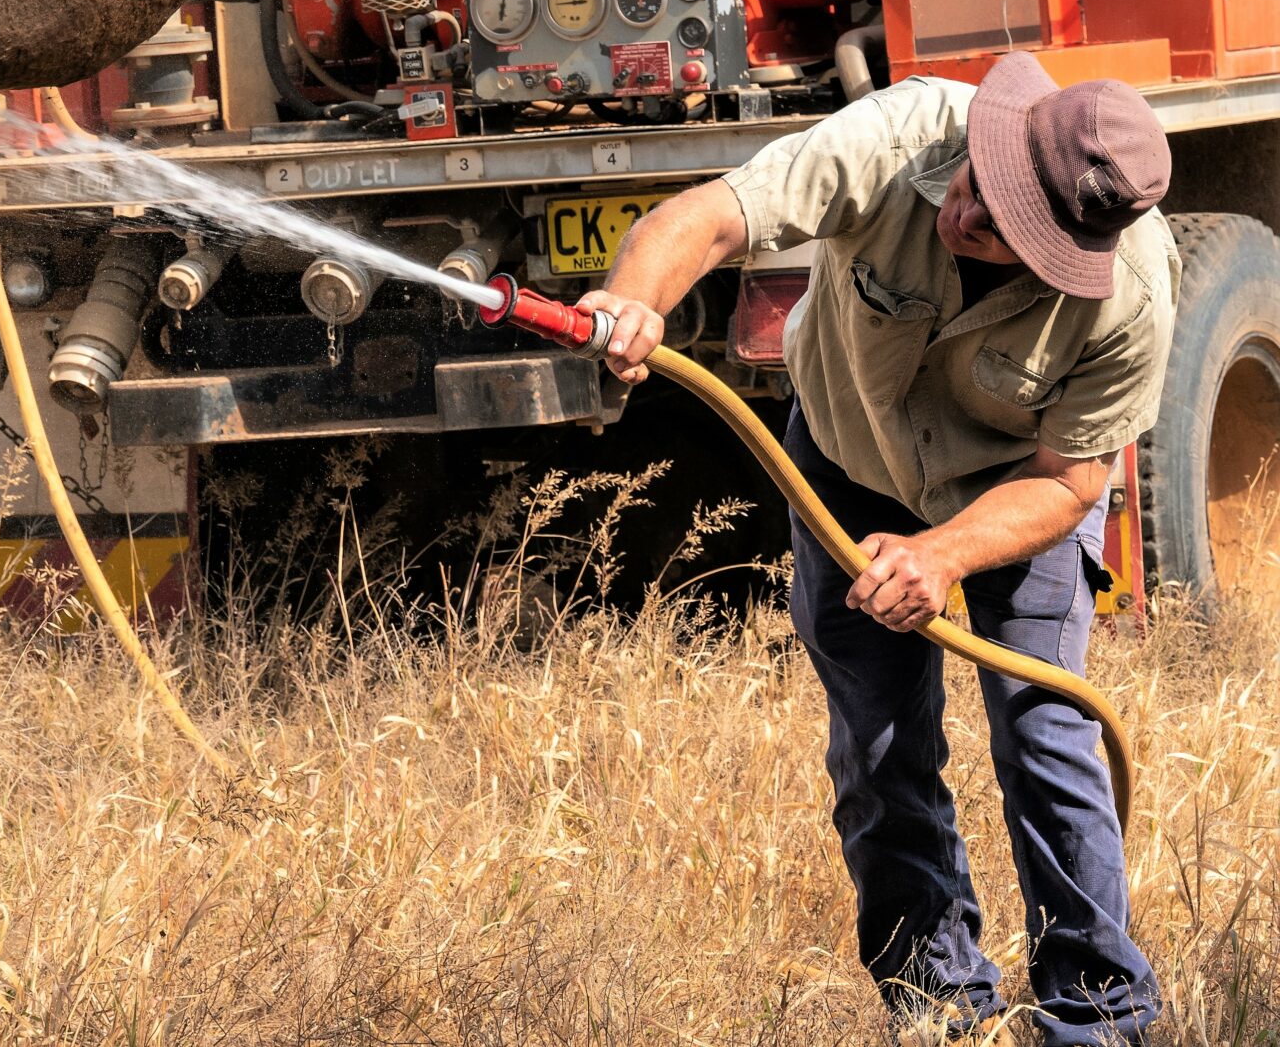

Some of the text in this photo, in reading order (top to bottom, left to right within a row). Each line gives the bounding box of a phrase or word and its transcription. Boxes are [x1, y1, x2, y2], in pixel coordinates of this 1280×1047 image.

[459, 158, 470, 171] 3
[607, 153, 617, 165] 4
[279, 158, 400, 189] 2 OUTLET
[573, 256, 606, 269] NEW
